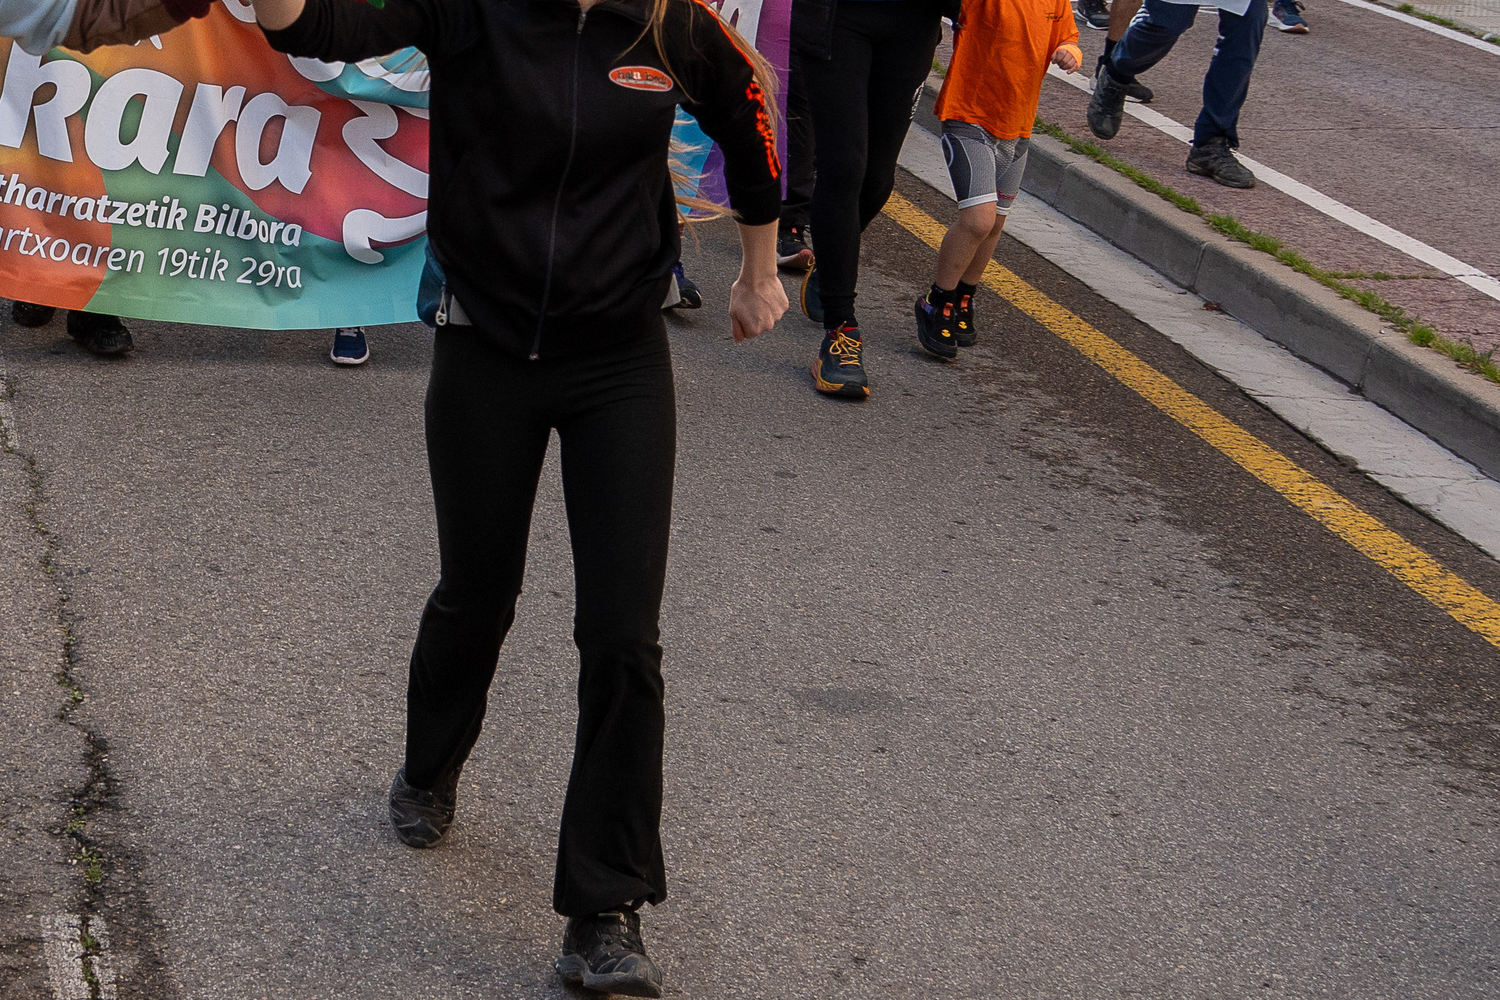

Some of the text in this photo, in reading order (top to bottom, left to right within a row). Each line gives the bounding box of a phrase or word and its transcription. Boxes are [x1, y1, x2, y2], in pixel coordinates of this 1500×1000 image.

[193, 203, 302, 248] Bilbora
[156, 246, 229, 282] 19tik
[236, 256, 302, 289] 29ra
